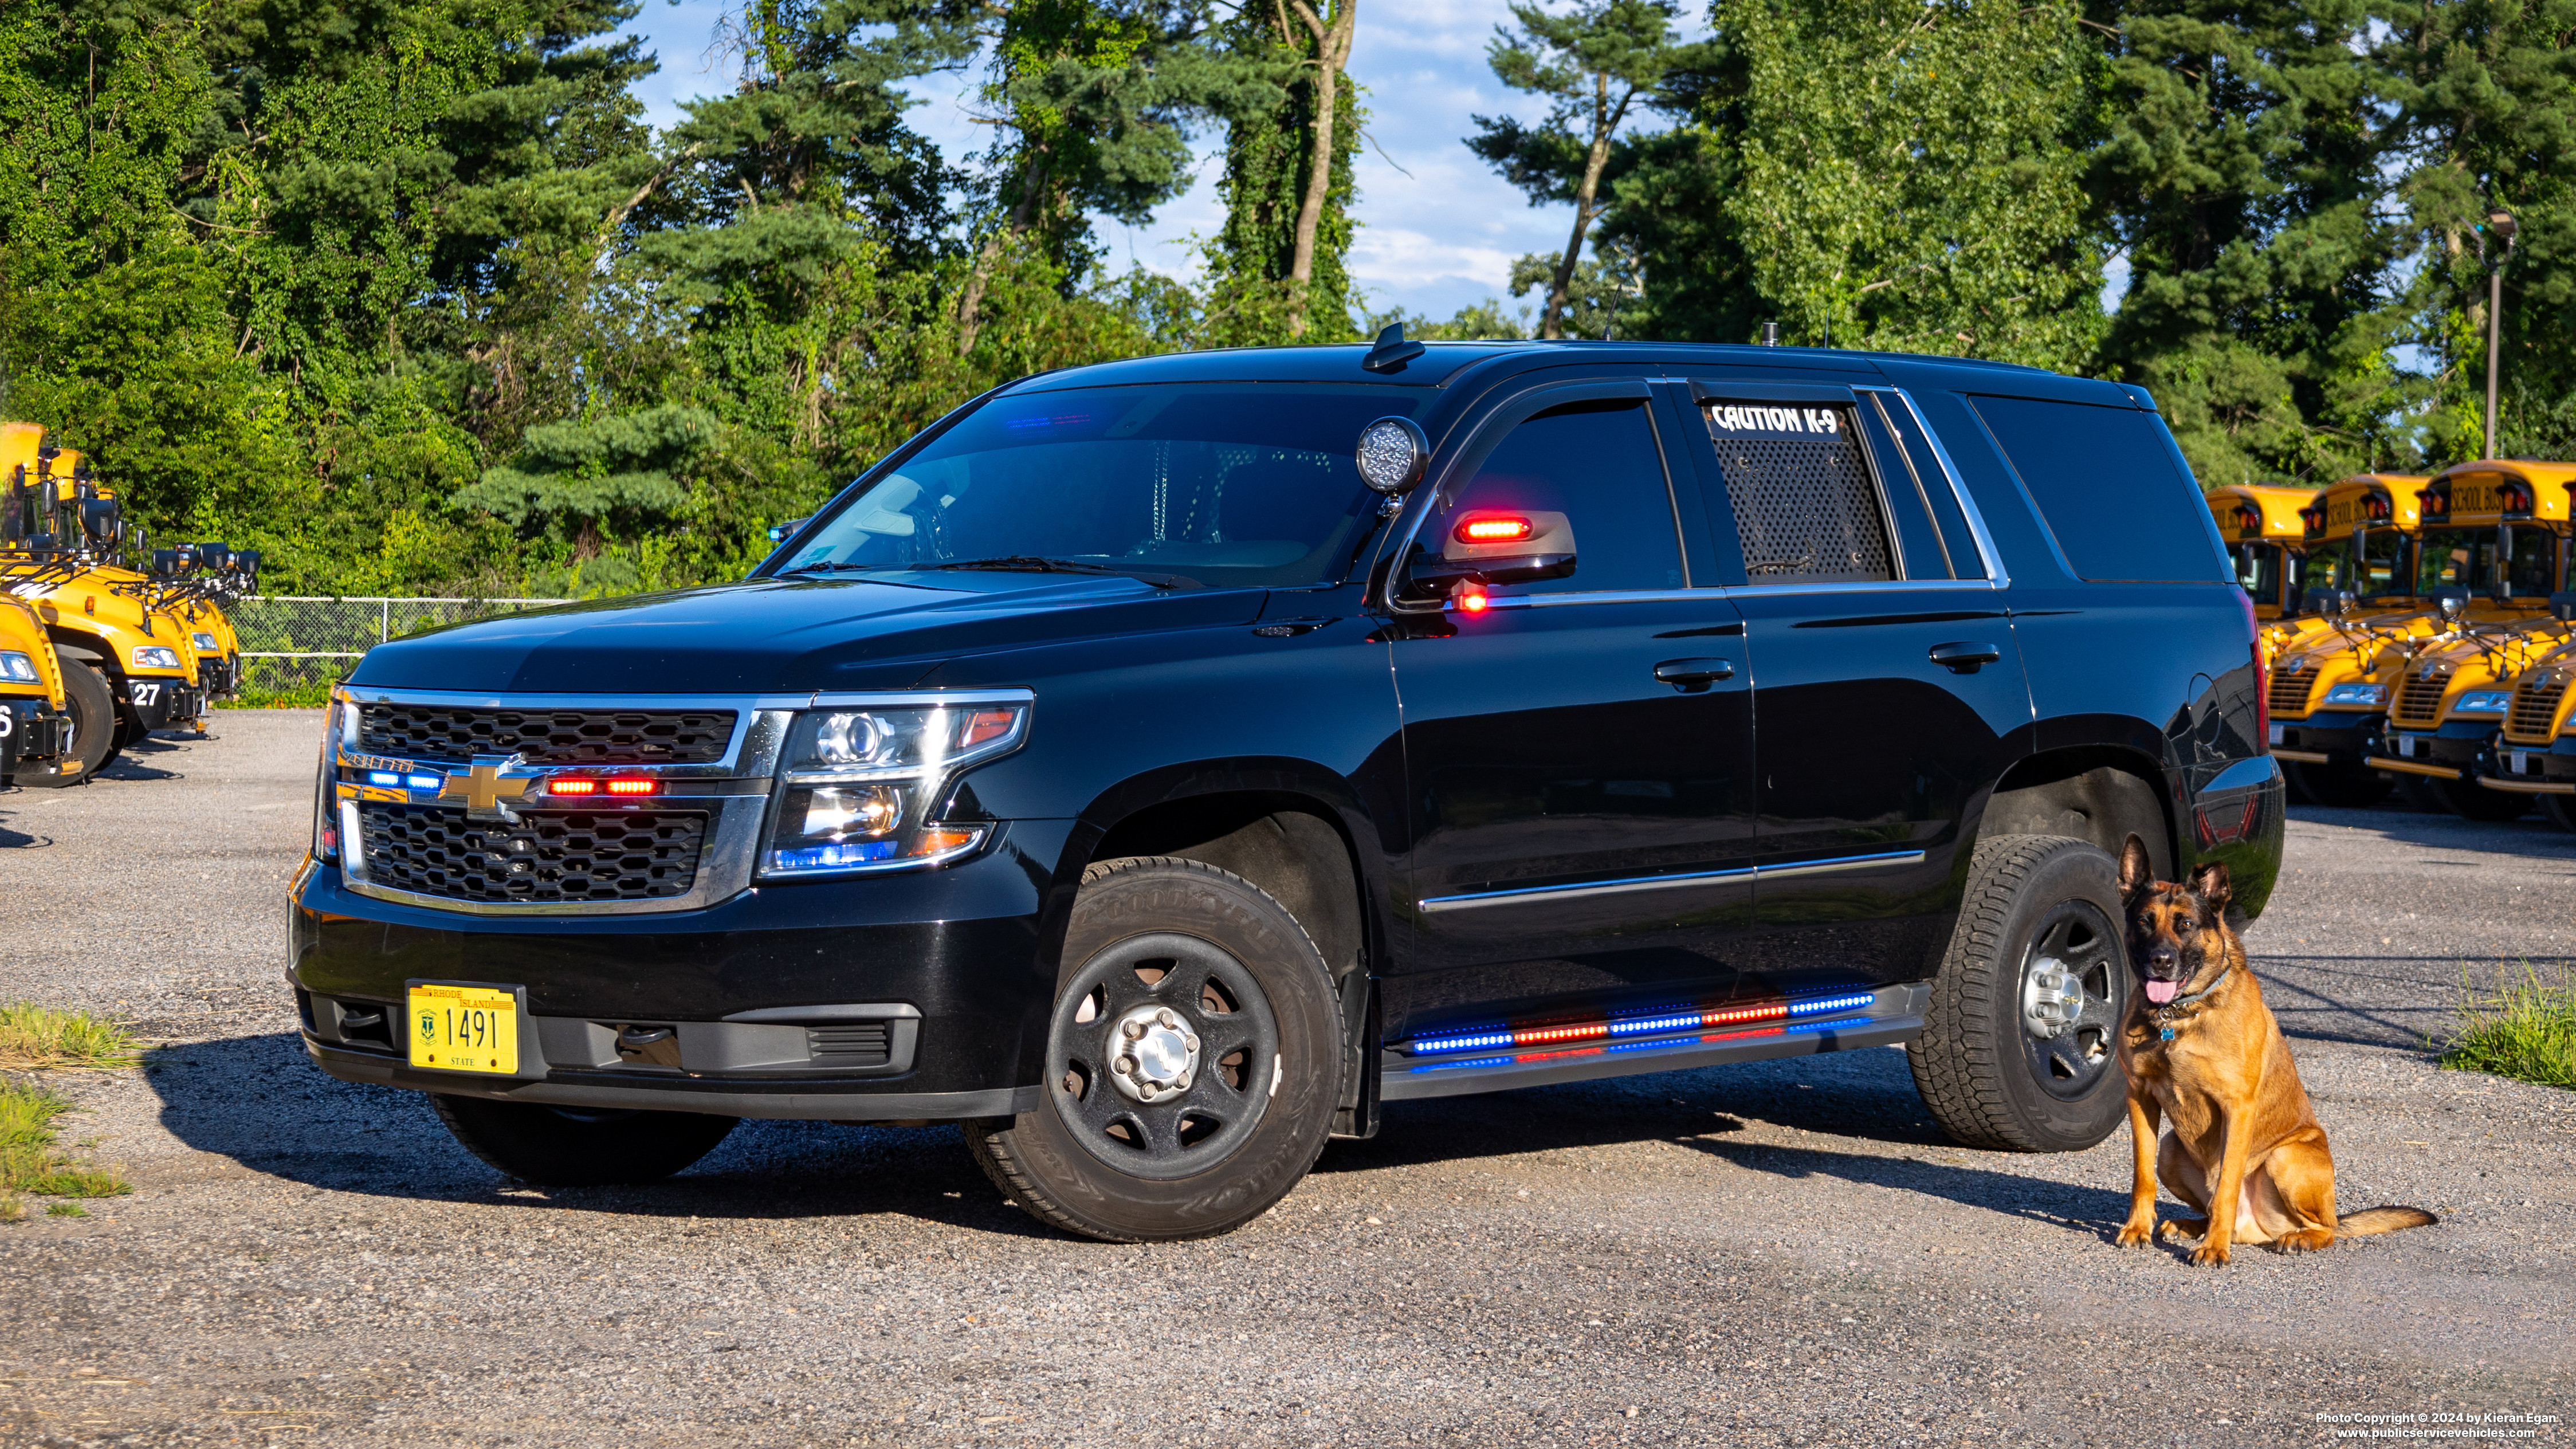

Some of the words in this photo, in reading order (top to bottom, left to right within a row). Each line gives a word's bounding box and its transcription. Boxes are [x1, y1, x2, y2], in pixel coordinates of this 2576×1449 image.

[1711, 404, 1803, 432] CAUTION
[1803, 409, 1837, 434] K-9
[2451, 486, 2483, 512] SCHOOL
[2484, 486, 2502, 511] BUS
[2328, 500, 2352, 527] SCHOOL
[134, 684, 160, 706] 27
[433, 989, 463, 999] RHODE
[459, 999, 491, 1009] ISLAND
[447, 1008, 496, 1049] 1491
[450, 1057, 475, 1066] STATE
